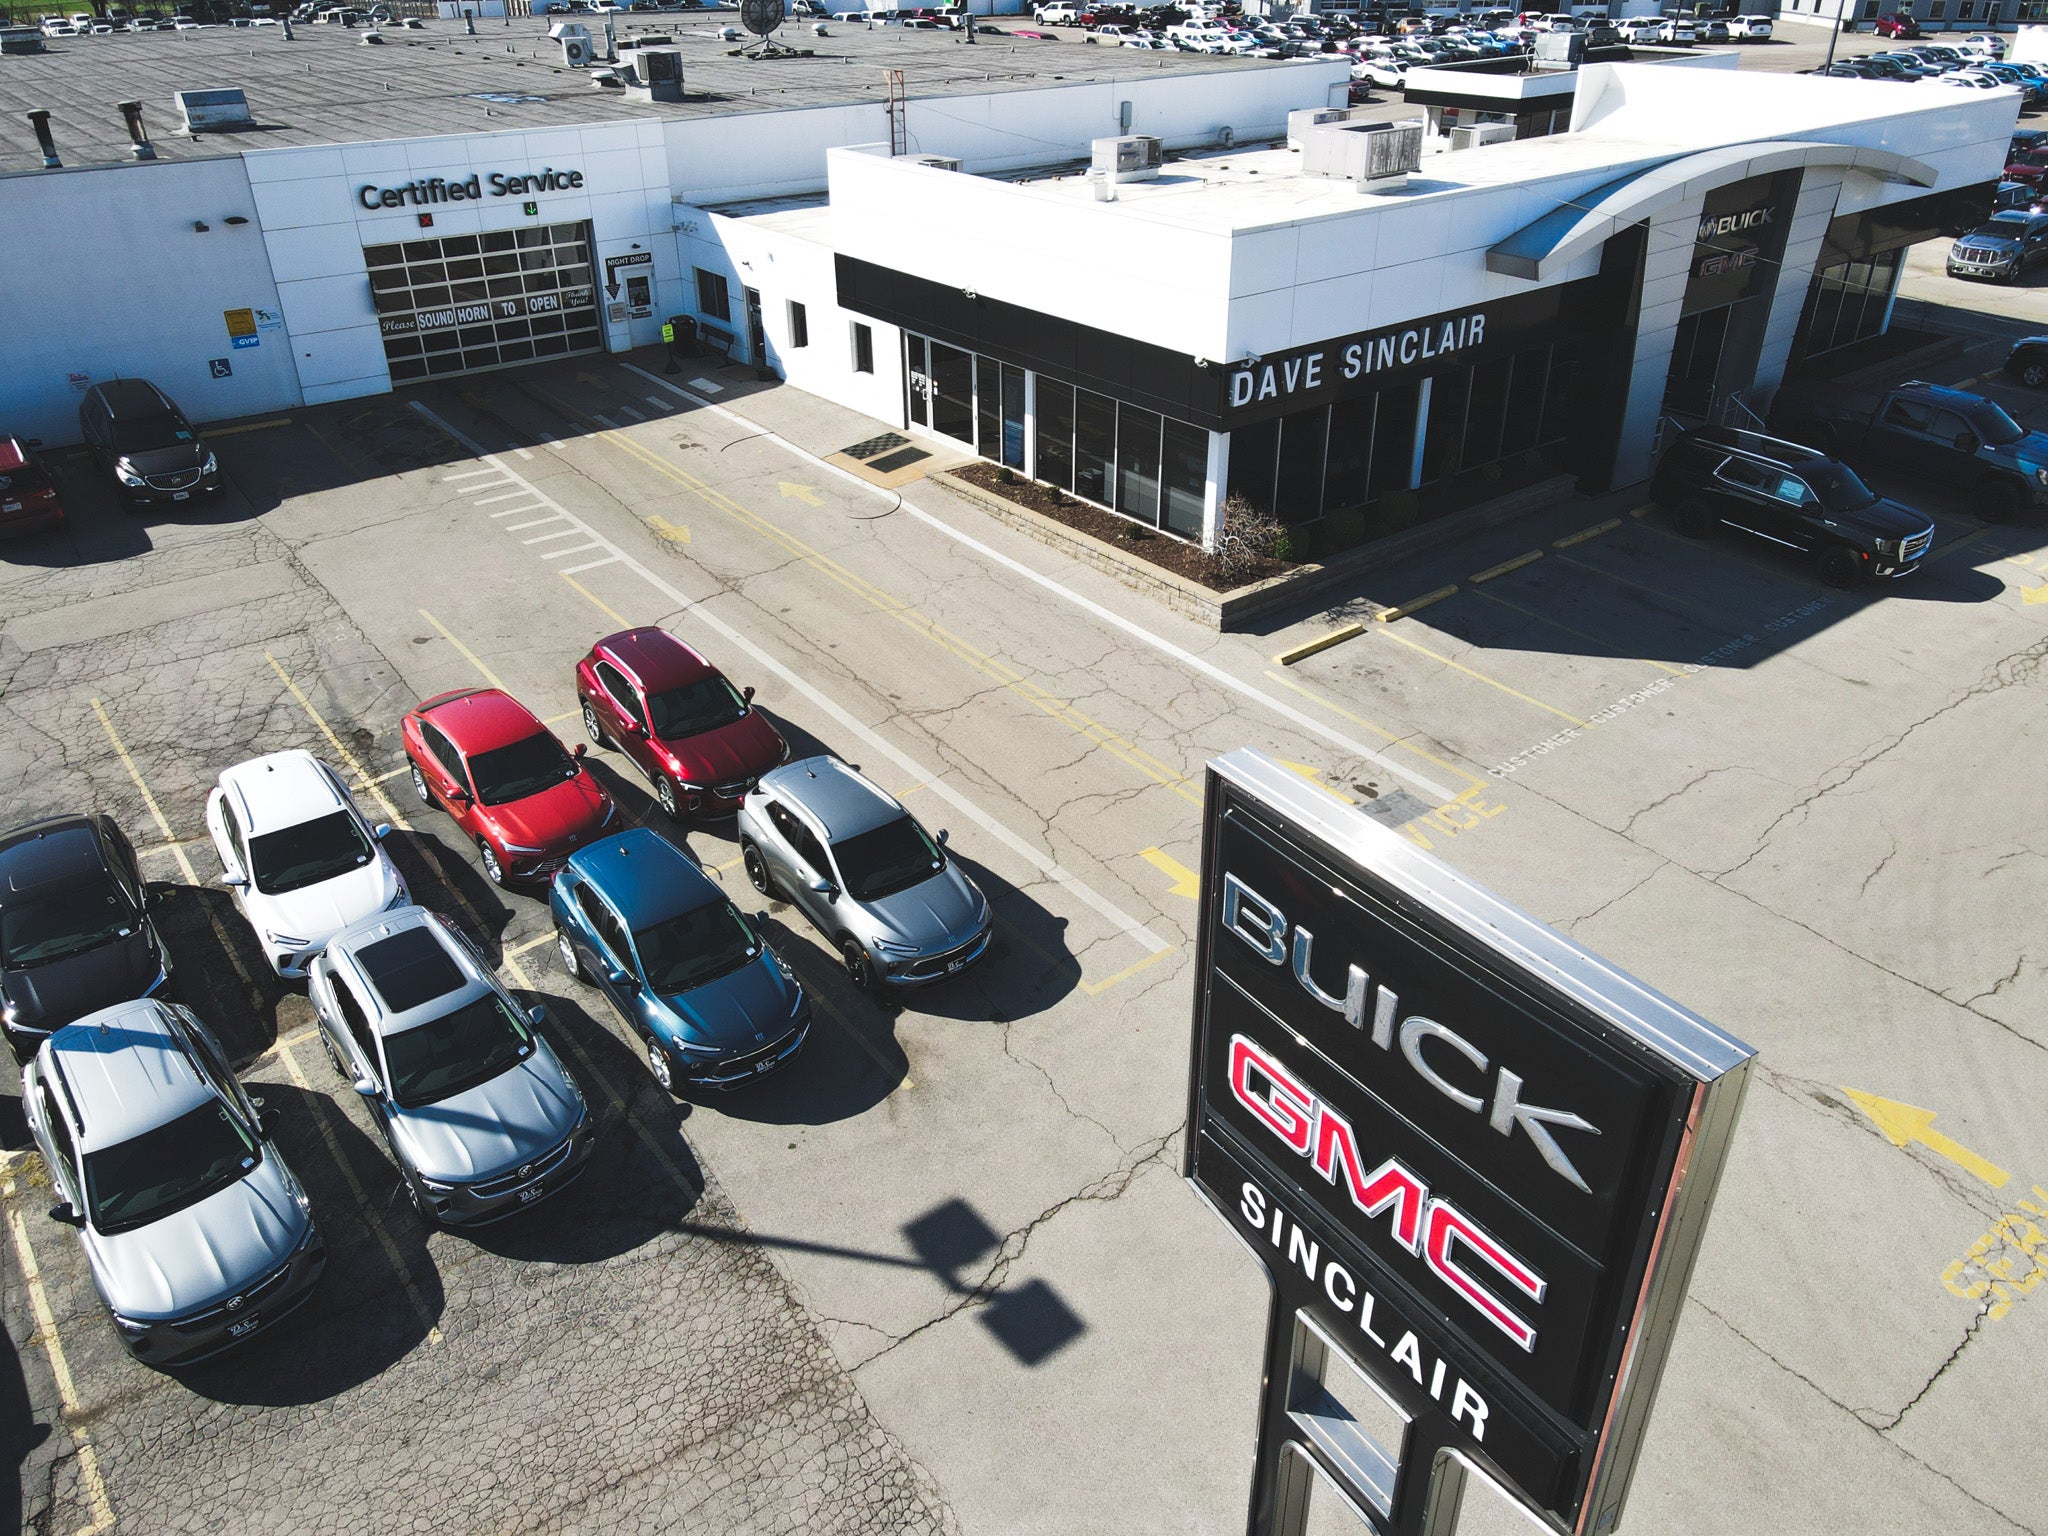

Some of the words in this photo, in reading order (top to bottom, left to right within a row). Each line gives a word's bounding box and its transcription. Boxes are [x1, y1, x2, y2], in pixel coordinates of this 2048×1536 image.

[359, 174, 482, 210] Certified
[490, 167, 584, 197] Service
[1717, 206, 1775, 235] BUICK
[607, 257, 629, 266] NIGHT
[630, 254, 650, 263] DROP
[1700, 247, 1760, 278] GMC
[382, 319, 415, 332] Please
[418, 310, 454, 328] SOUND
[457, 305, 489, 323] HORN
[501, 301, 516, 316] TO
[530, 295, 558, 312] OPEN
[1230, 352, 1323, 408] DAVE
[1342, 314, 1486, 379] SINCLAIR
[1683, 633, 1760, 674] CUSTOMER
[1589, 678, 1675, 724] CUSTOMER
[1488, 728, 1582, 779] CUSTOMER
[1222, 871, 1601, 1194] BUICK
[1228, 1033, 1548, 1354] GMC
[1241, 1182, 1489, 1442] SINCLAIR
